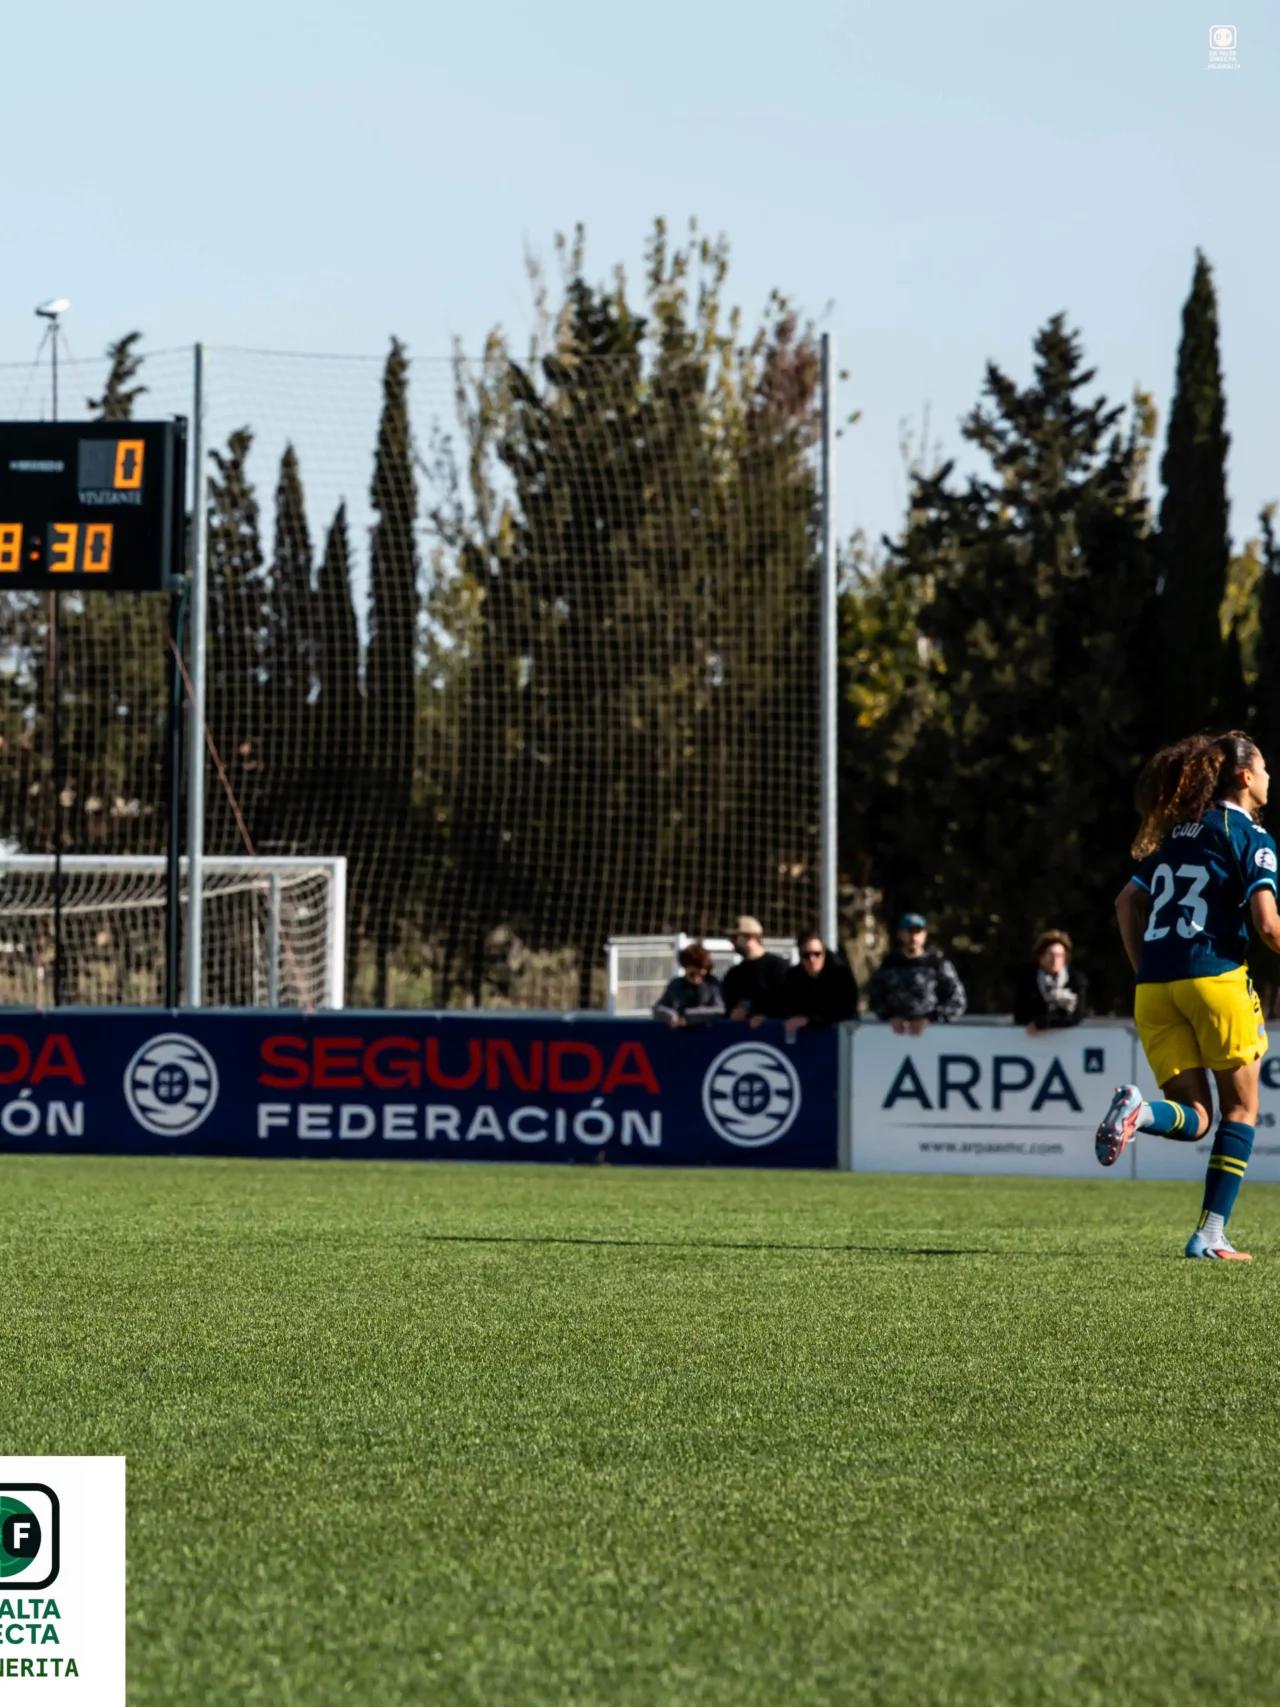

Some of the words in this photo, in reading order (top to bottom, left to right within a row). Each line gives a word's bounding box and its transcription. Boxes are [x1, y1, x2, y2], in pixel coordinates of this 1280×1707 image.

[113, 439, 145, 489] 0
[1144, 863, 1211, 941] 23
[257, 1034, 661, 1095] SEGUNDA
[881, 1054, 1084, 1112] ARPA
[257, 1097, 662, 1147] FEDERACIÓN
